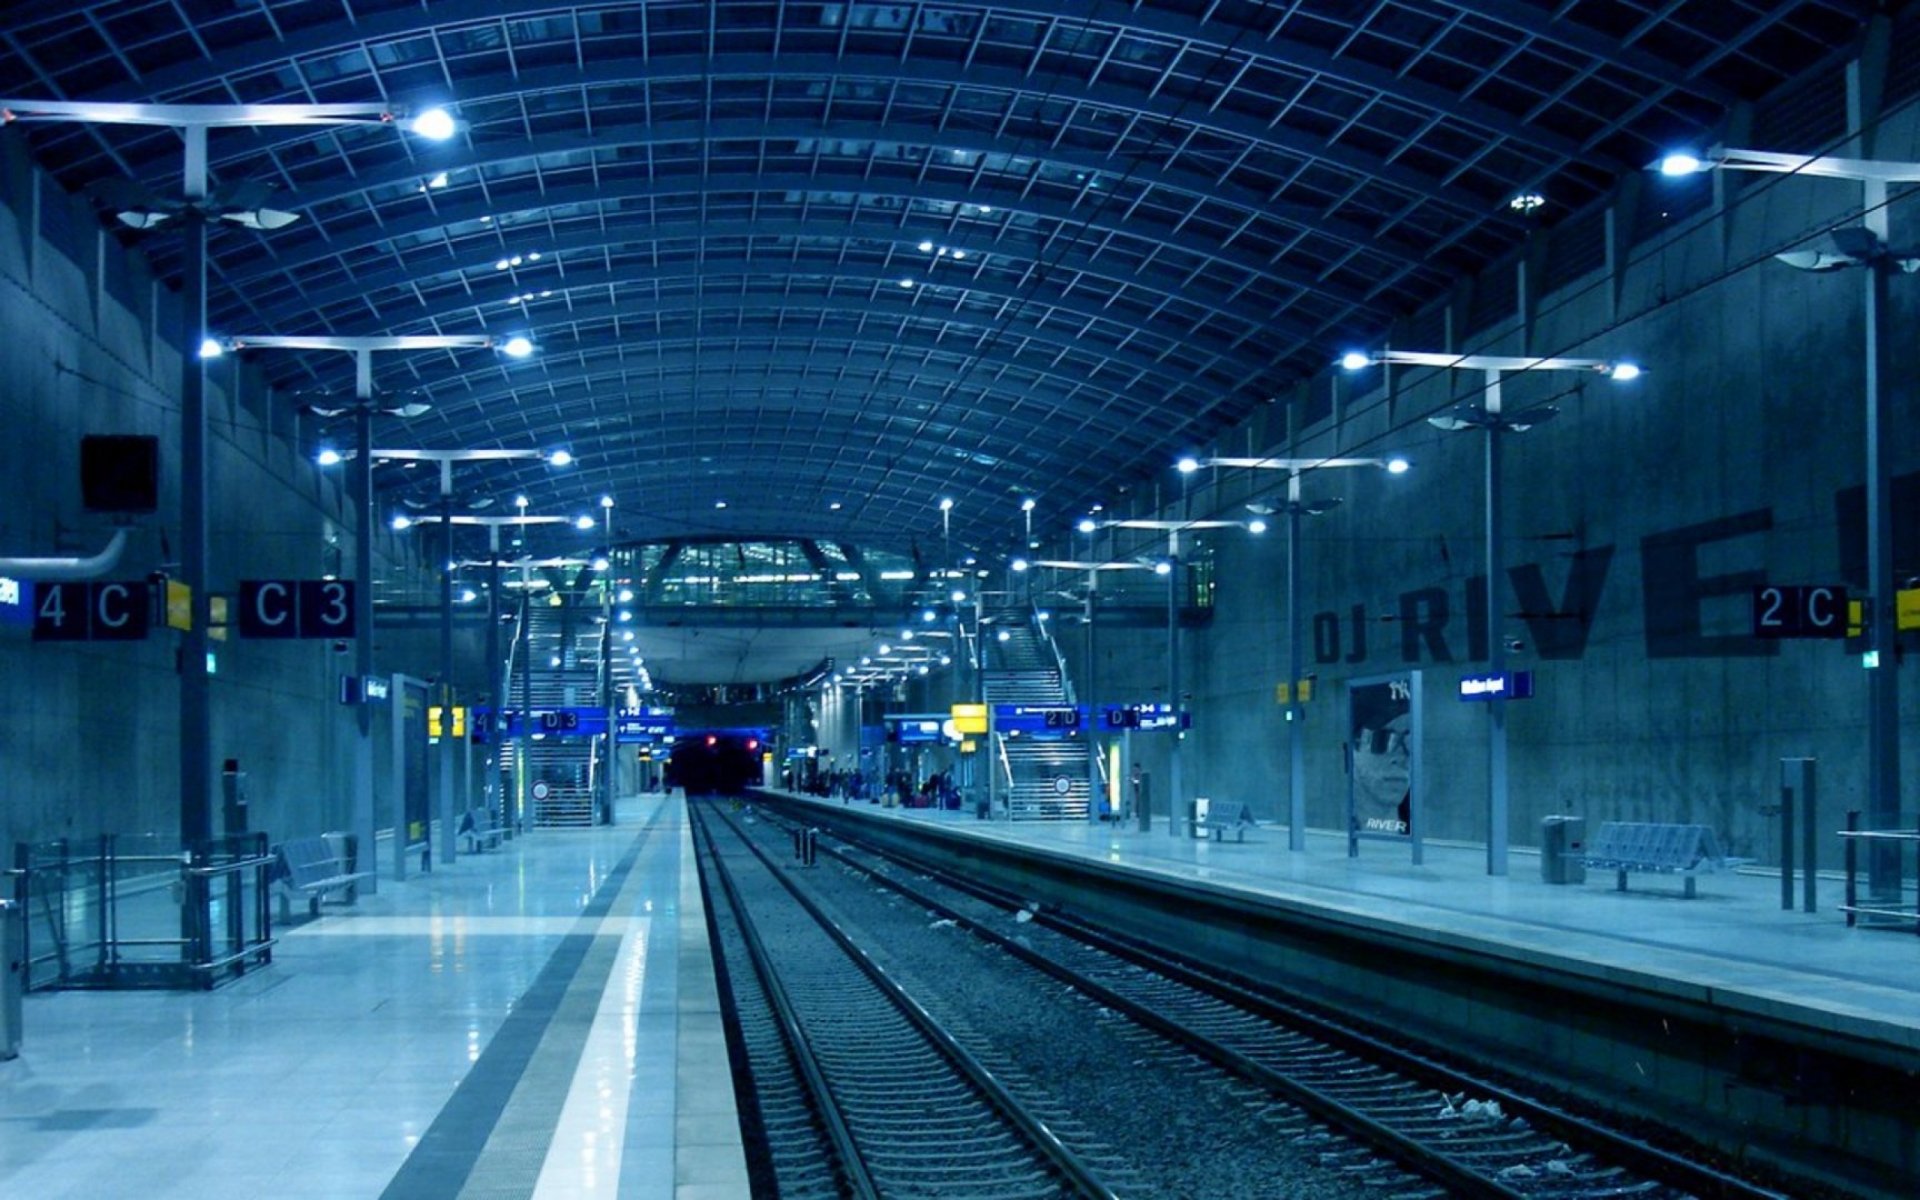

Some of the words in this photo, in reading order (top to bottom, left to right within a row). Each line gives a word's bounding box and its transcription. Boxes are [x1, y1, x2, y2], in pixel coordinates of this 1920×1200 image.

[40, 584, 66, 627] 4
[99, 584, 130, 627] C
[257, 583, 287, 625] C
[322, 583, 347, 625] 3
[1761, 588, 1782, 625] 2
[1808, 588, 1834, 626] C
[546, 713, 558, 728] D
[566, 712, 577, 728] 3
[1047, 711, 1059, 725] 2
[1065, 711, 1075, 725] D
[1112, 711, 1122, 724] D
[1366, 818, 1408, 832] RIVER
